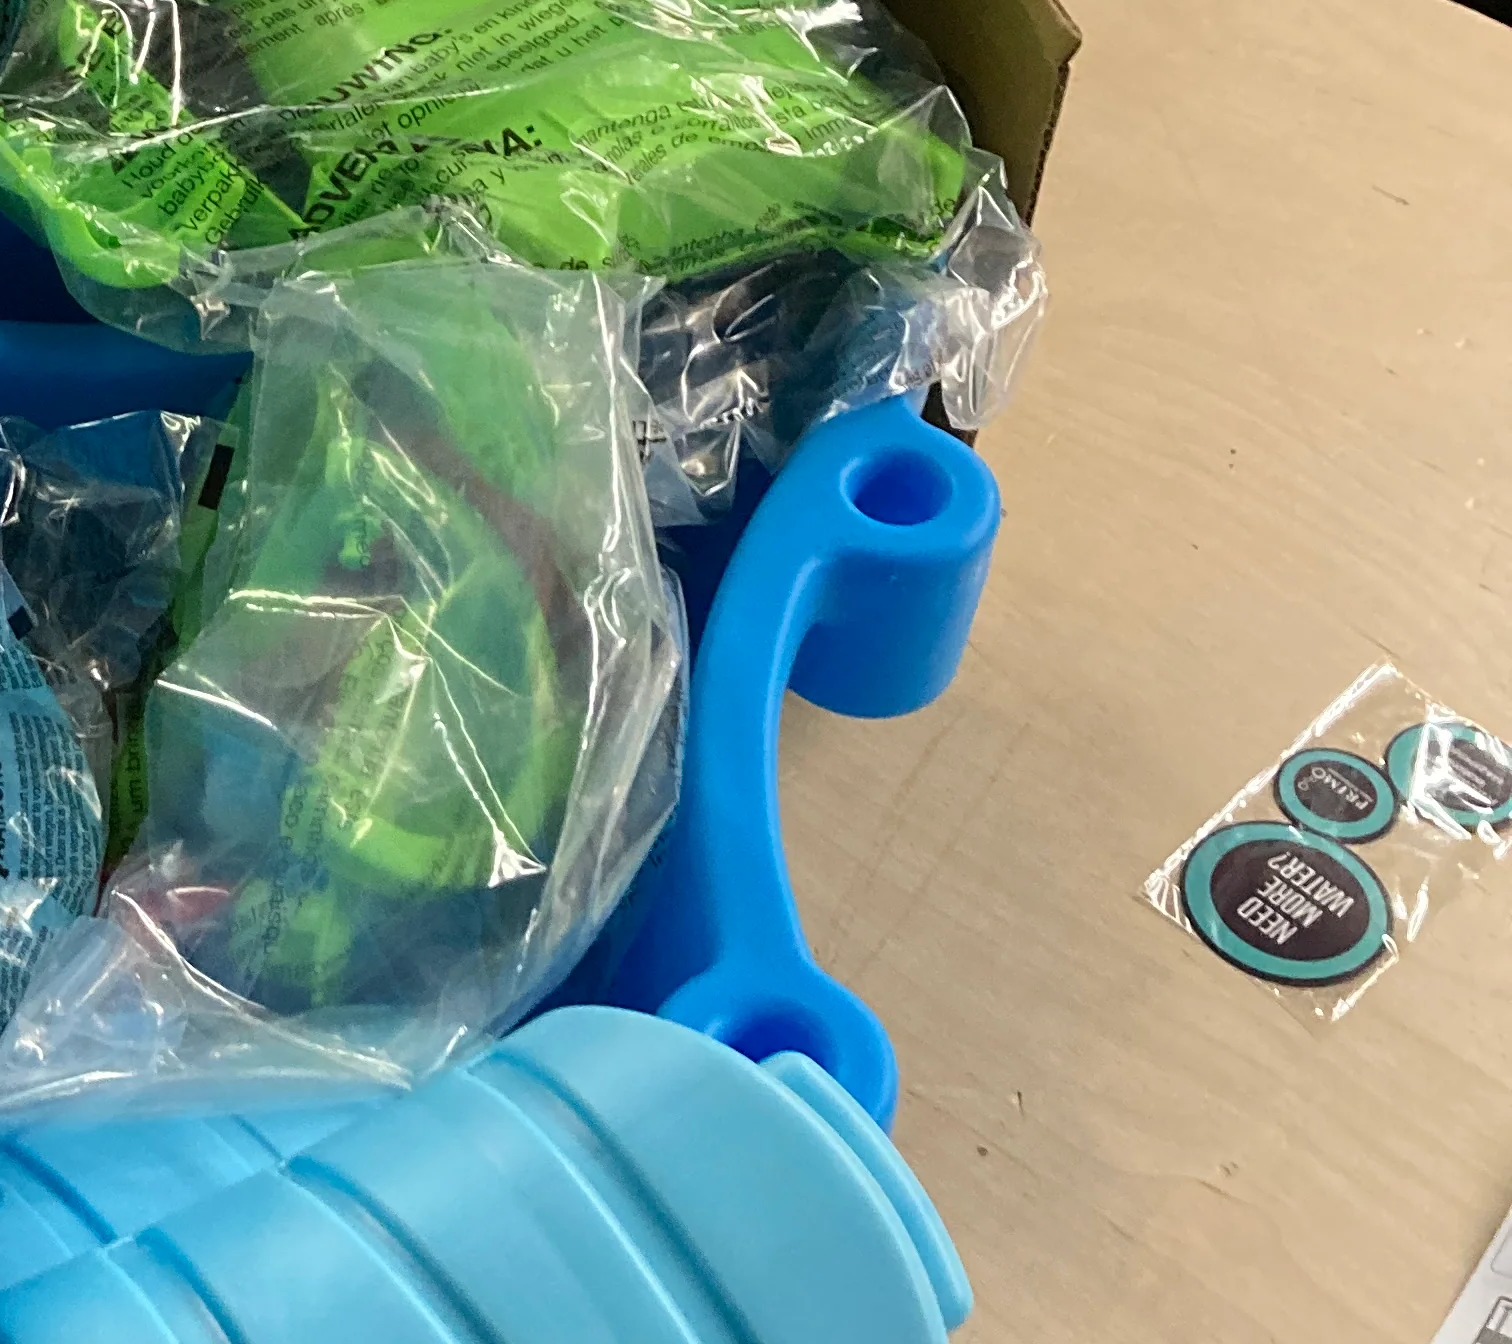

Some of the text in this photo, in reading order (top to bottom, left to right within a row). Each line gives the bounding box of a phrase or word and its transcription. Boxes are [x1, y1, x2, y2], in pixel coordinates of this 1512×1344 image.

[1310, 766, 1373, 812] PRIMO
[1256, 877, 1324, 930] MORE
[1267, 852, 1355, 918] WATER?
[1236, 893, 1299, 945] NEED
